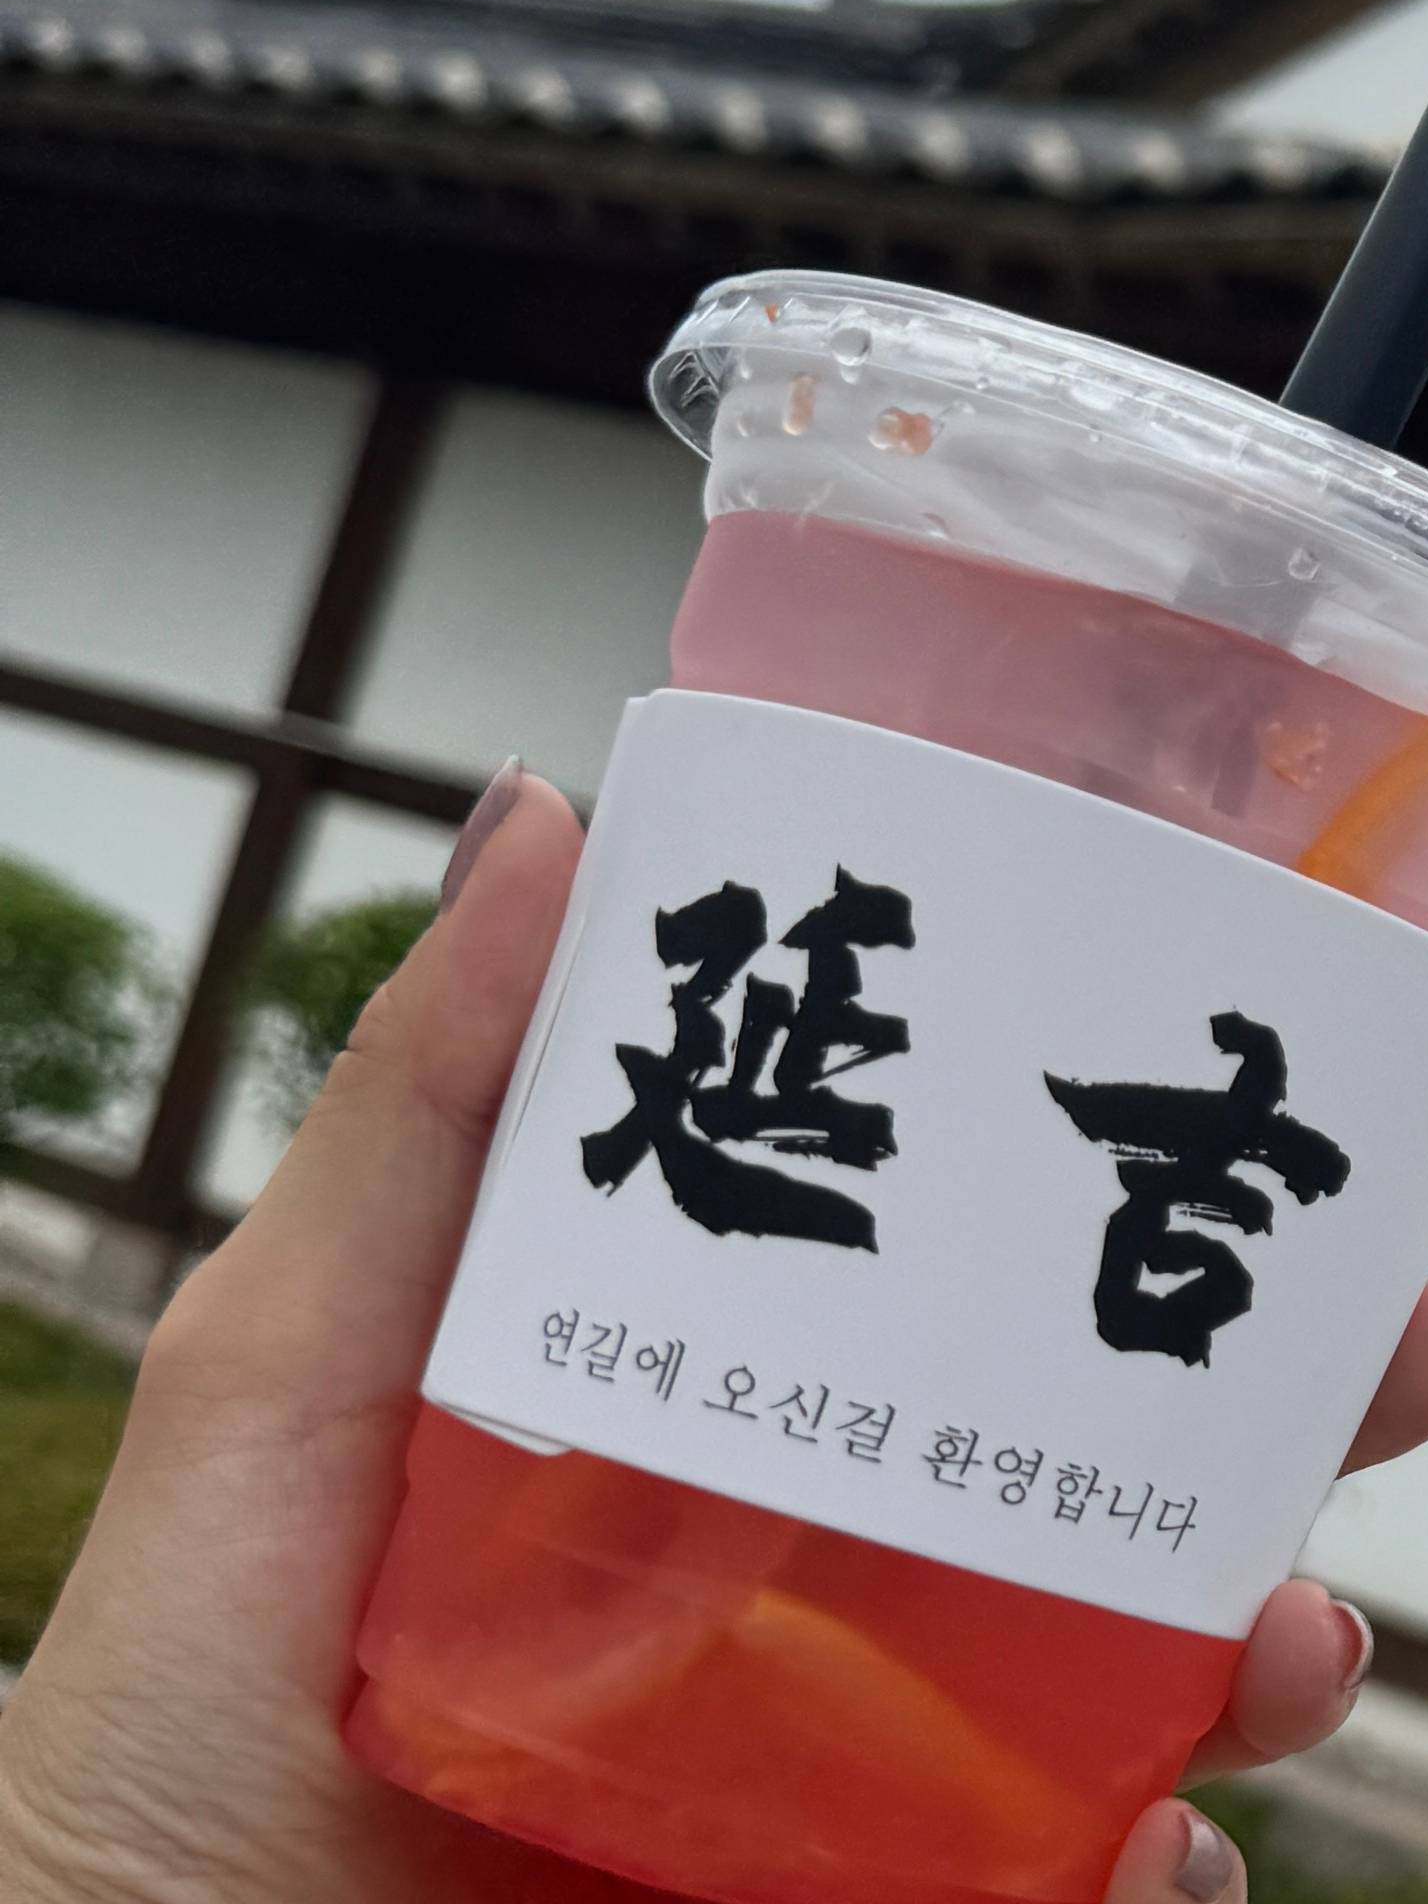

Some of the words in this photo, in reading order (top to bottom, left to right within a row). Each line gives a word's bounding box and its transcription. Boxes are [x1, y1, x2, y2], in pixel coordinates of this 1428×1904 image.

[581, 864, 1351, 1369] 延吉
[543, 1308, 686, 1402] 연길에
[703, 1365, 896, 1464] 오신걸
[922, 1425, 1198, 1553] 환영합니다
